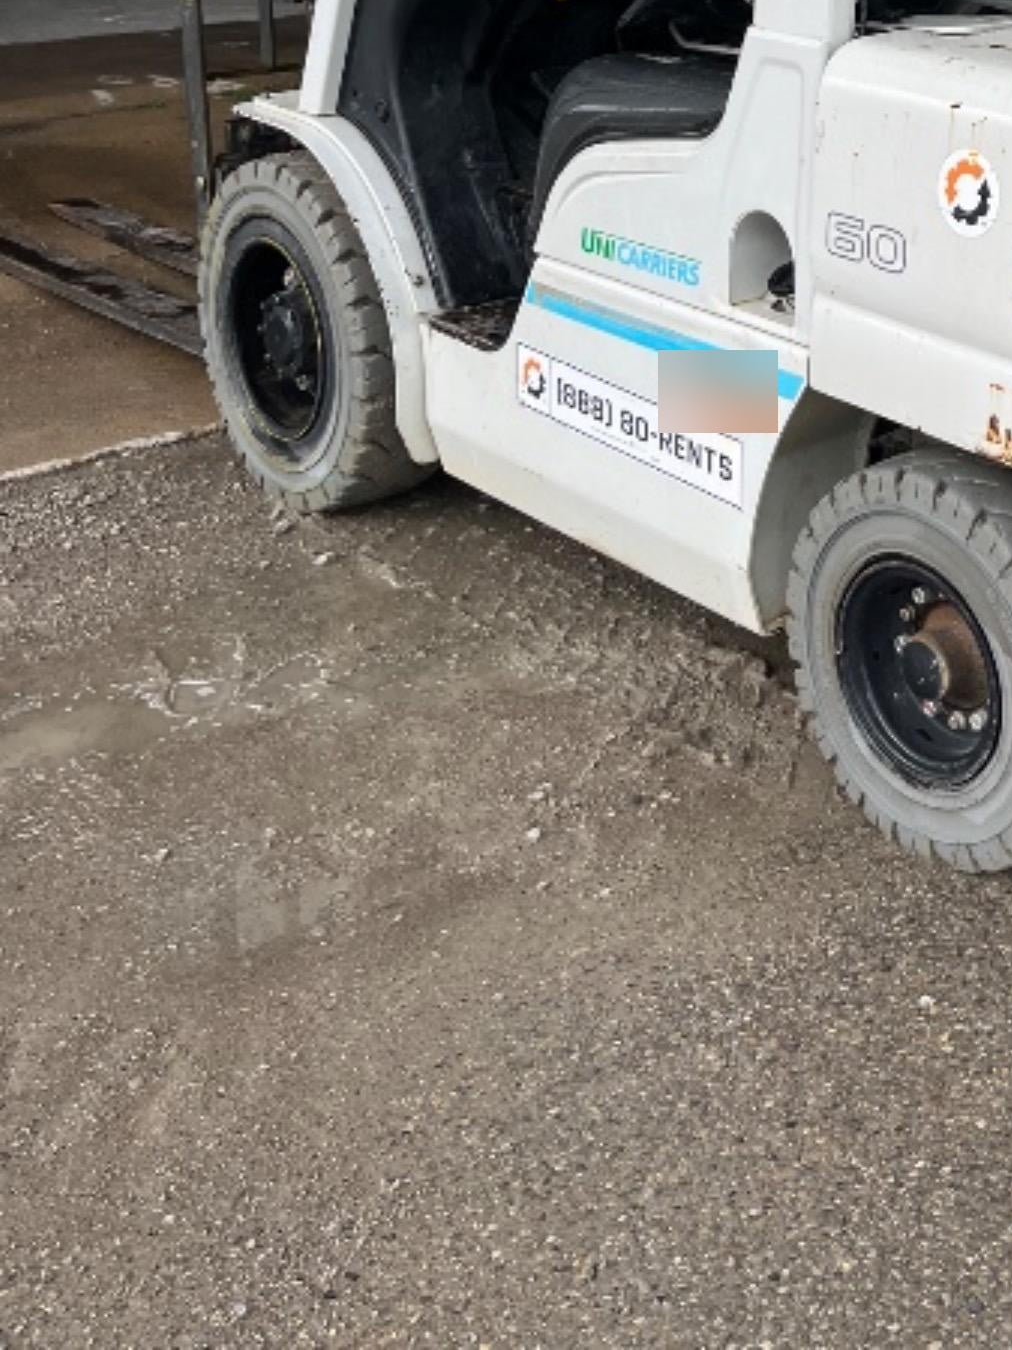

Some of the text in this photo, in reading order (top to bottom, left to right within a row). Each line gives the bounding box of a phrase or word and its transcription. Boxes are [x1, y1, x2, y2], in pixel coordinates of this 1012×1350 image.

[826, 210, 906, 274] 60
[556, 377, 613, 427] (888)
[619, 409, 733, 481] 80-RENTS
